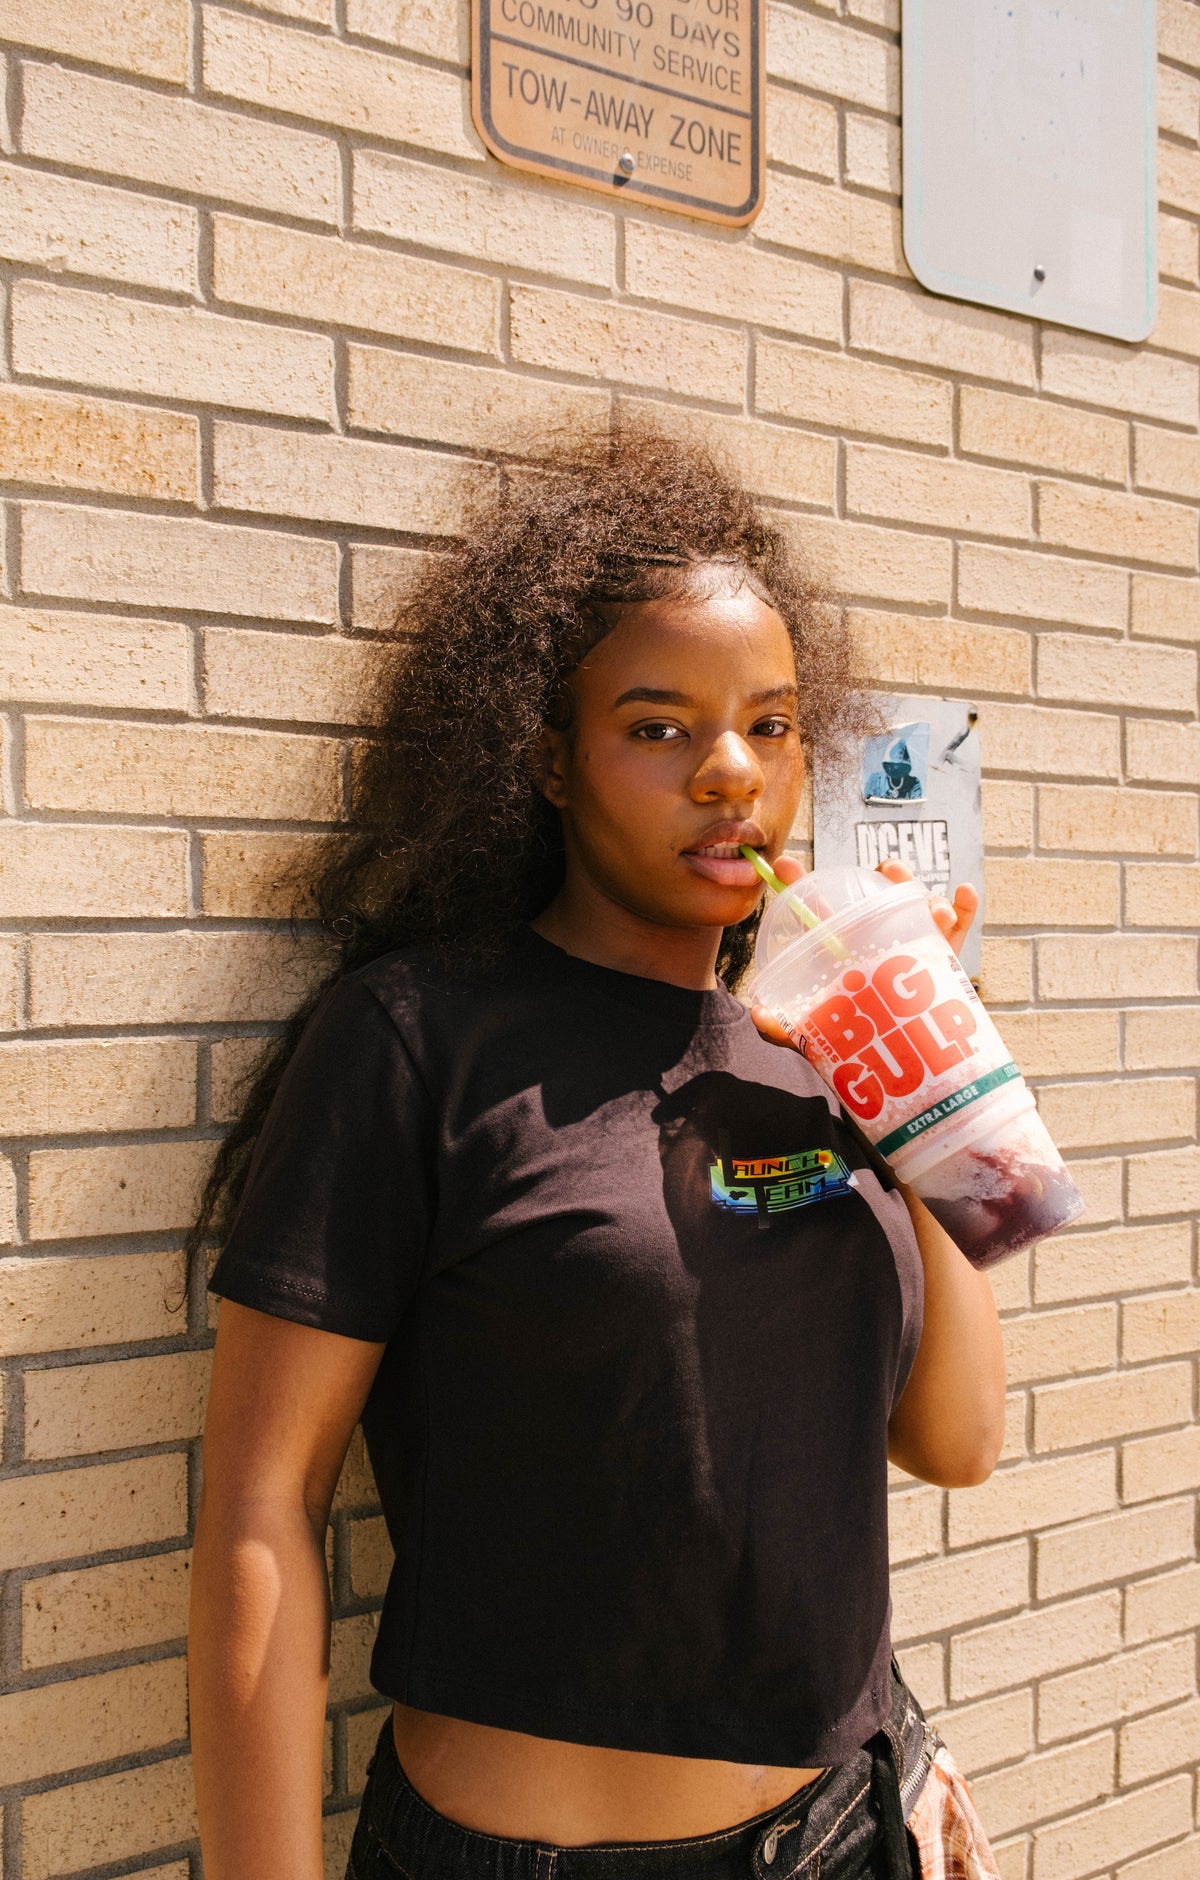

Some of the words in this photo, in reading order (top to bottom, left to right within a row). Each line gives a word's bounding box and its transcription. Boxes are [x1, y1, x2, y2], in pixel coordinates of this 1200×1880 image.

[501, 0, 640, 62] COMMUNITY
[653, 45, 741, 95] SERVICE
[616, 0, 653, 28] 90
[671, 14, 741, 57] DAYS
[502, 62, 654, 139] TOW-AWAY
[670, 115, 741, 165] ZONE
[551, 126, 566, 145] AT
[637, 150, 693, 181] EXPENSE
[832, 999, 977, 1121] GULP
[907, 1108, 943, 1134] EXTRA
[941, 1085, 979, 1113] LARGE
